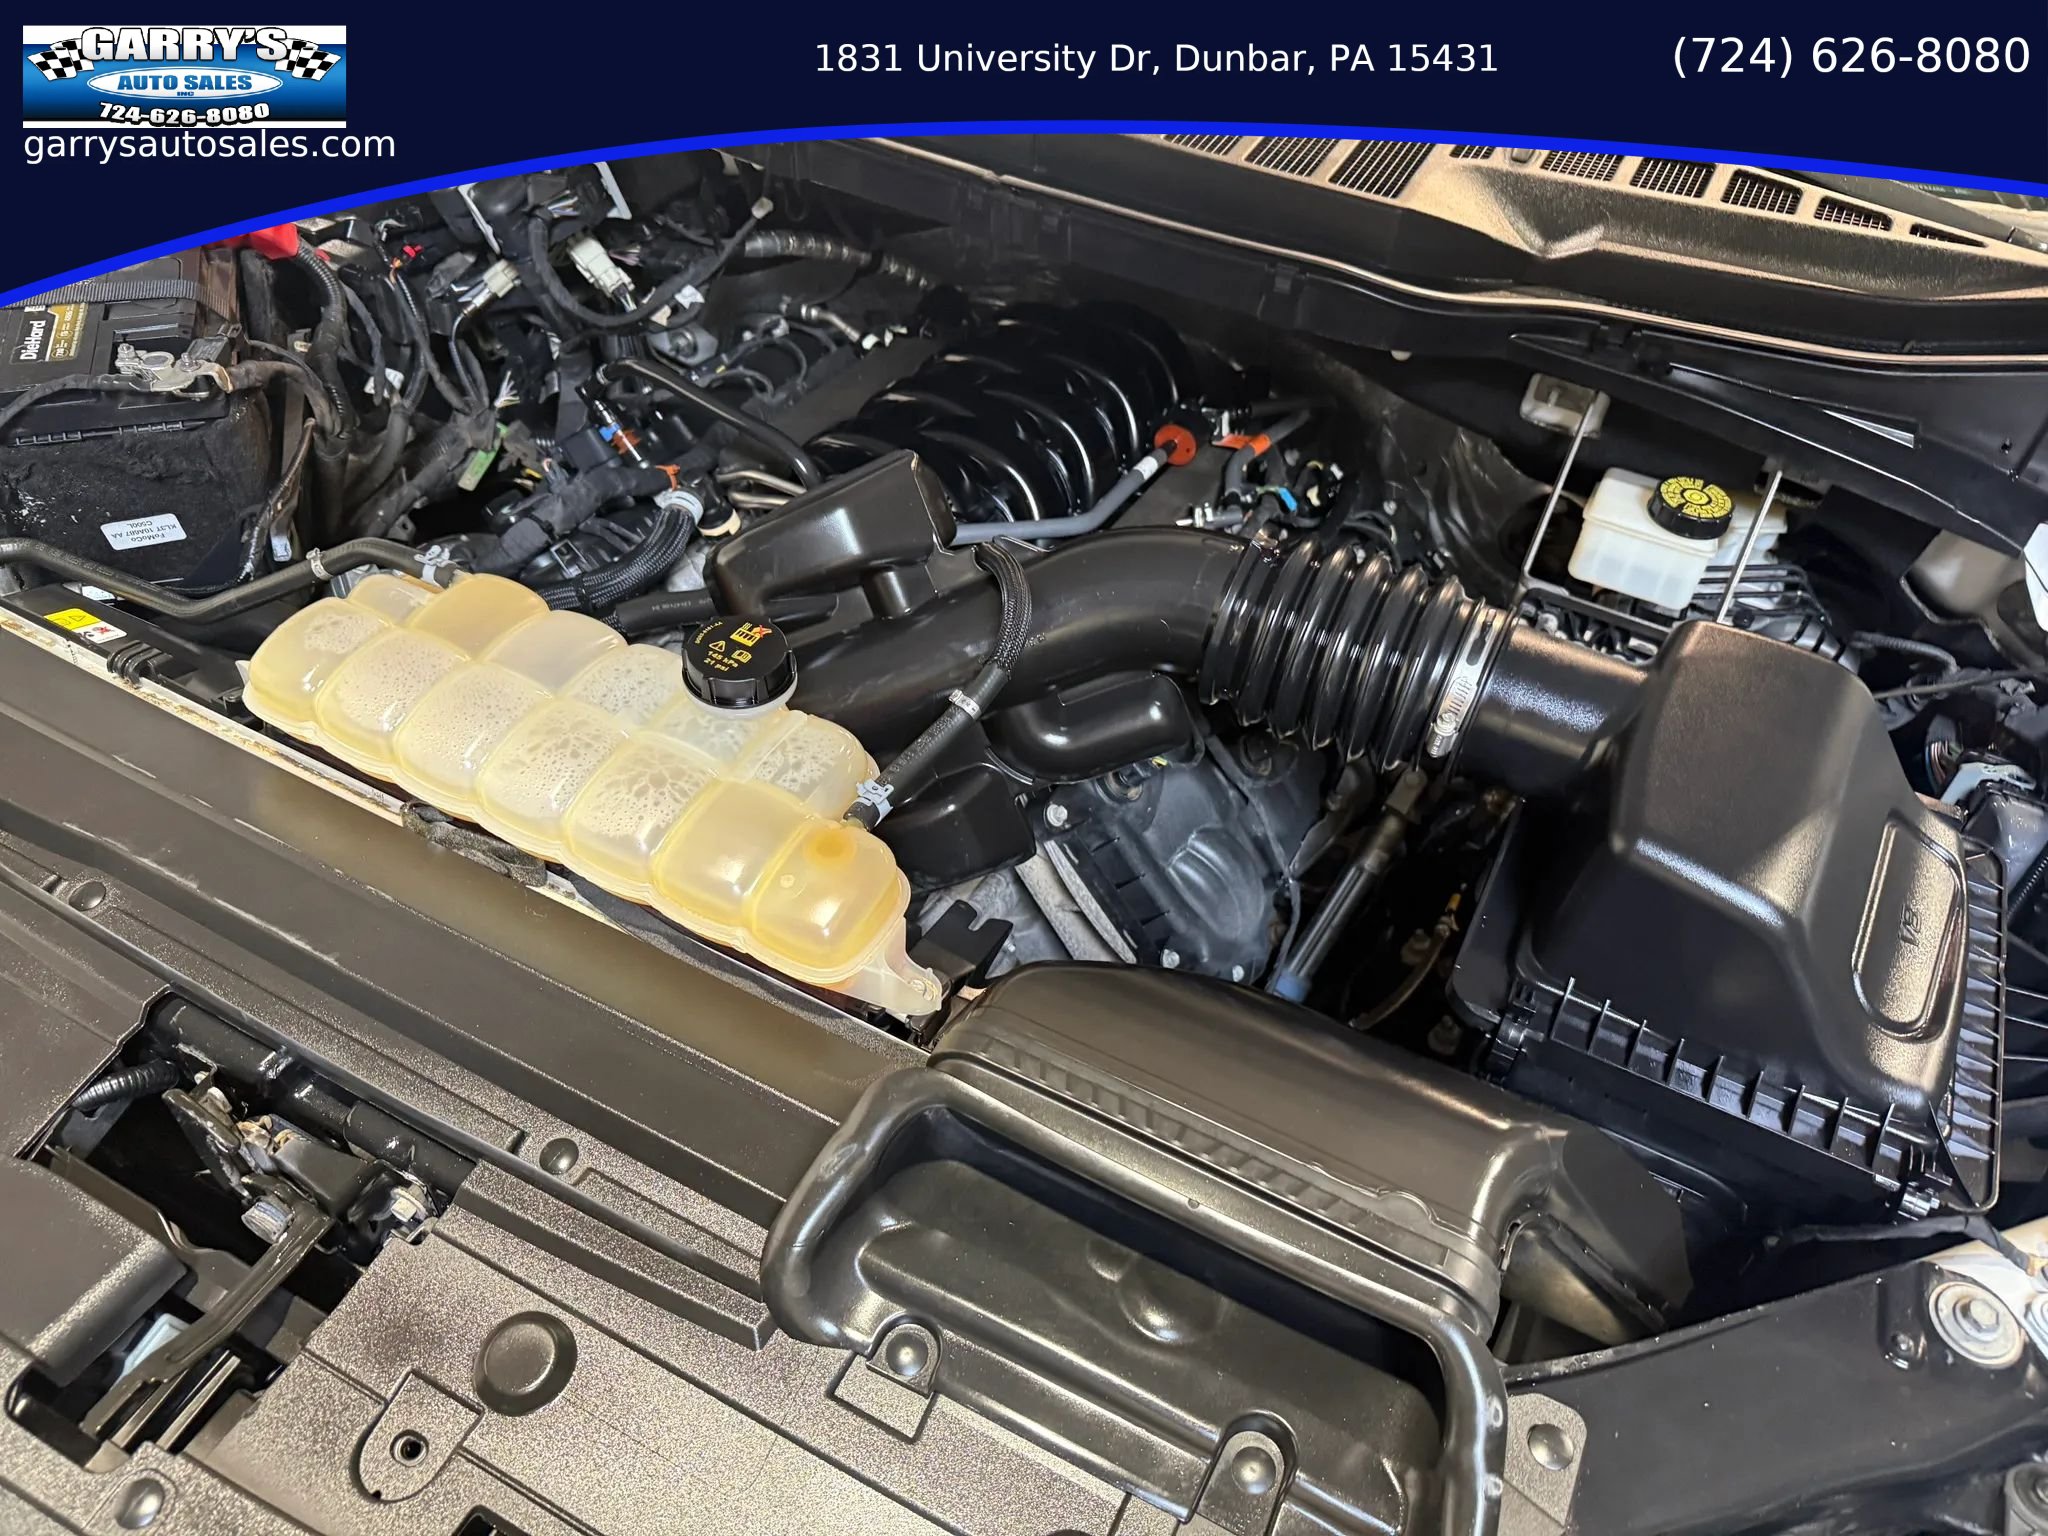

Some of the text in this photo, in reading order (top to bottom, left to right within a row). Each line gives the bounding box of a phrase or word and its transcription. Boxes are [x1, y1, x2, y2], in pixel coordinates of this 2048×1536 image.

[19, 320, 46, 360] DieHard
[131, 532, 166, 542] FoMoCo
[703, 657, 730, 672] 21 psi
[707, 650, 739, 668] 145 kPa
[1898, 903, 1921, 947] V8
